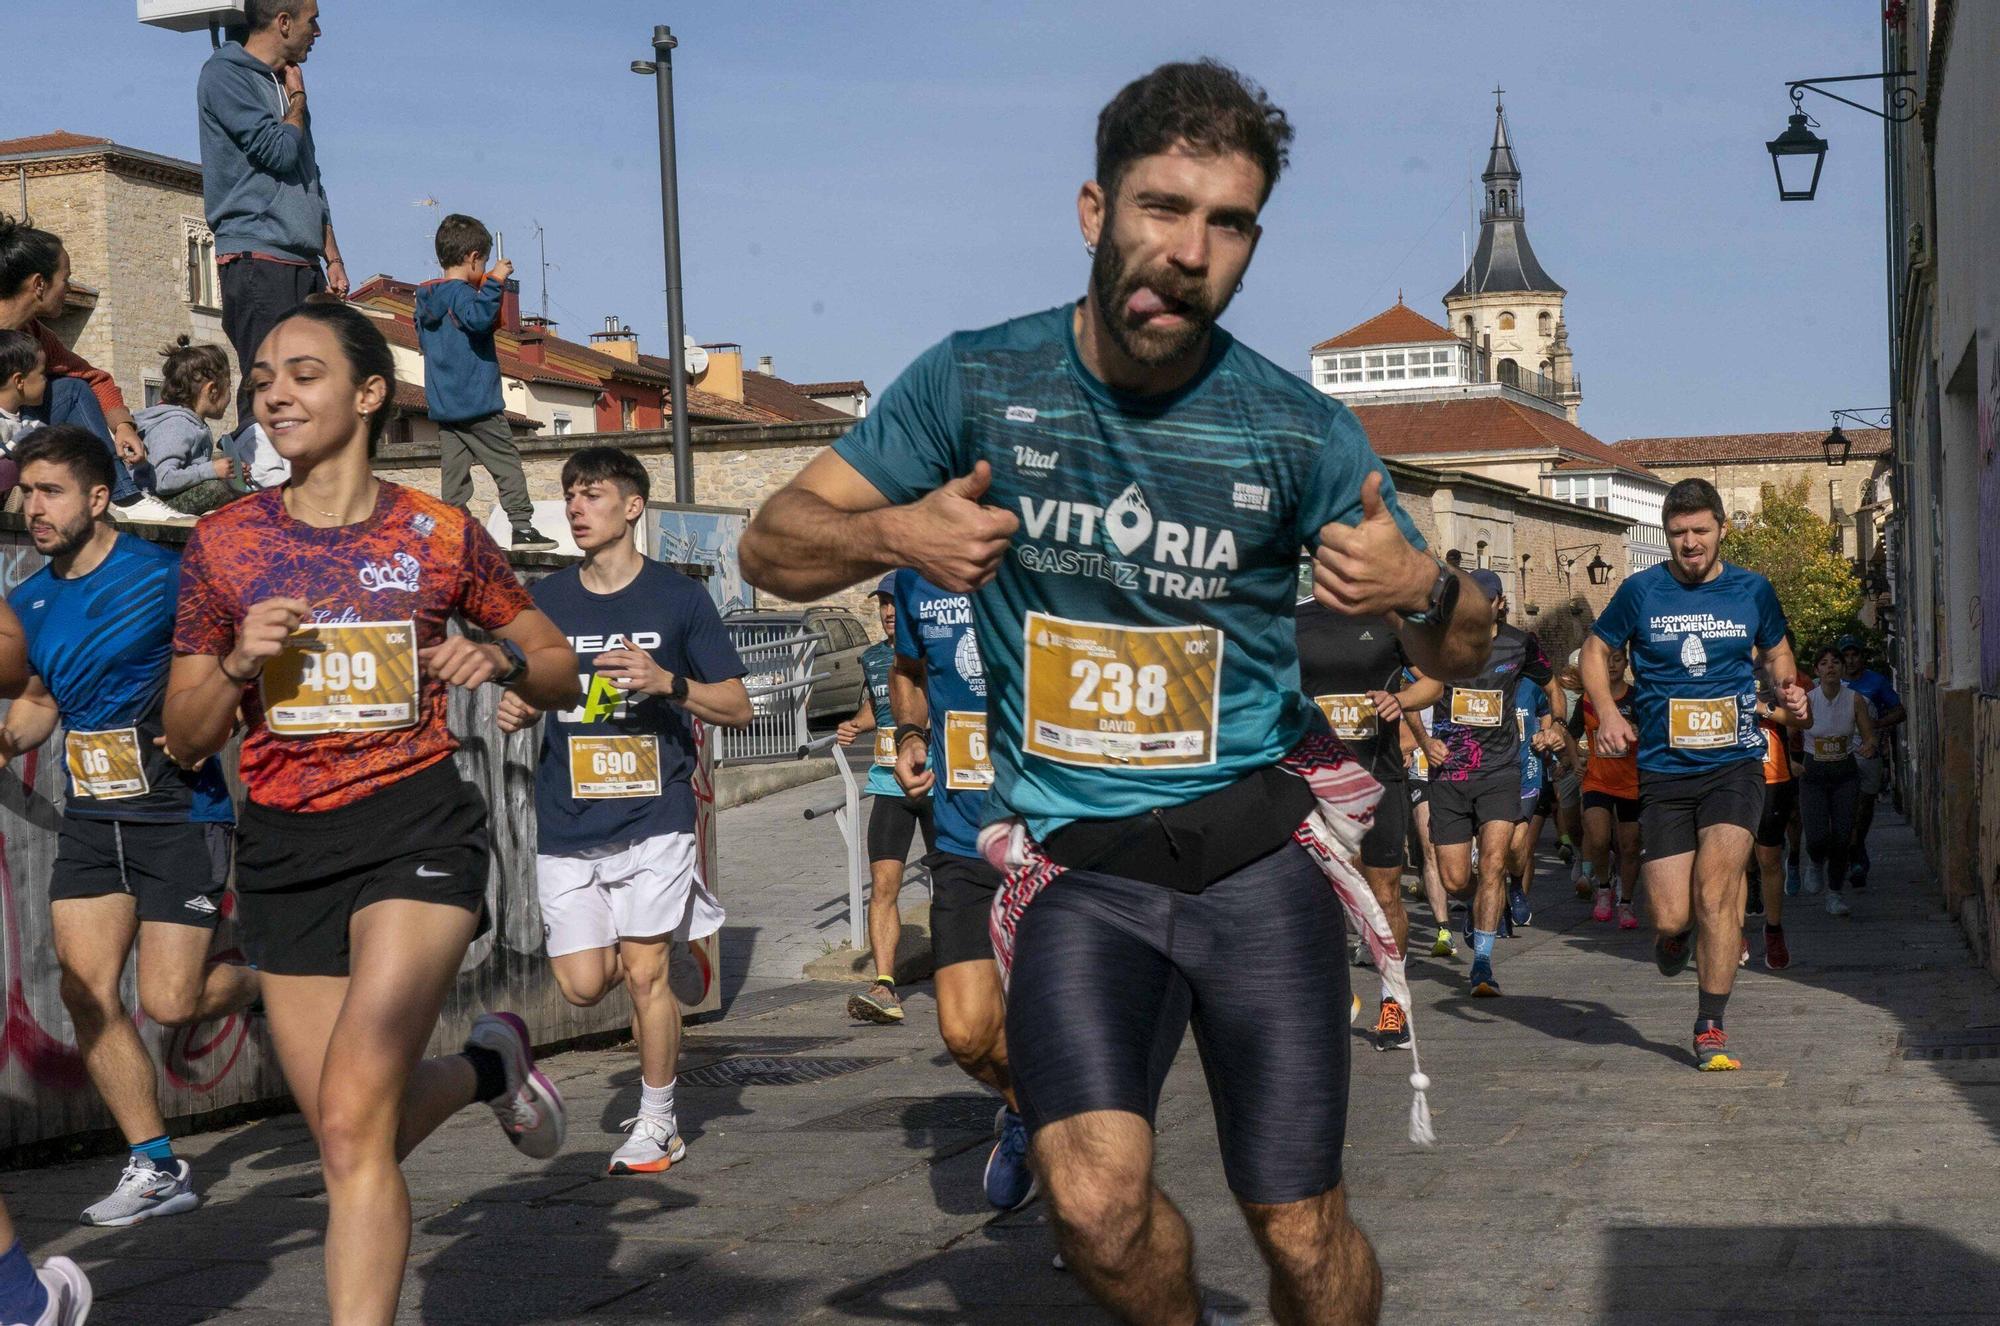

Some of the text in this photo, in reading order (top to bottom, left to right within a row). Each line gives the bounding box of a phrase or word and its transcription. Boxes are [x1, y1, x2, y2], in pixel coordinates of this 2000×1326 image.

[1013, 445, 1059, 470] Vital
[1144, 567, 1231, 600] TRAIL
[920, 600, 933, 611] LA
[936, 608, 974, 625] ALM
[1650, 613, 1715, 624] LA CONQUISTA
[1663, 619, 1735, 634] ALMENDRA
[1701, 629, 1748, 639] KONKISTA
[385, 632, 406, 644] 10K
[302, 651, 377, 692] 499
[1070, 658, 1169, 717] 238
[327, 694, 353, 705] ALBA
[1466, 698, 1489, 713] 143
[1330, 706, 1360, 723] 414
[1688, 711, 1722, 731] 626
[1099, 718, 1137, 733] DAVID
[592, 751, 637, 776] 690
